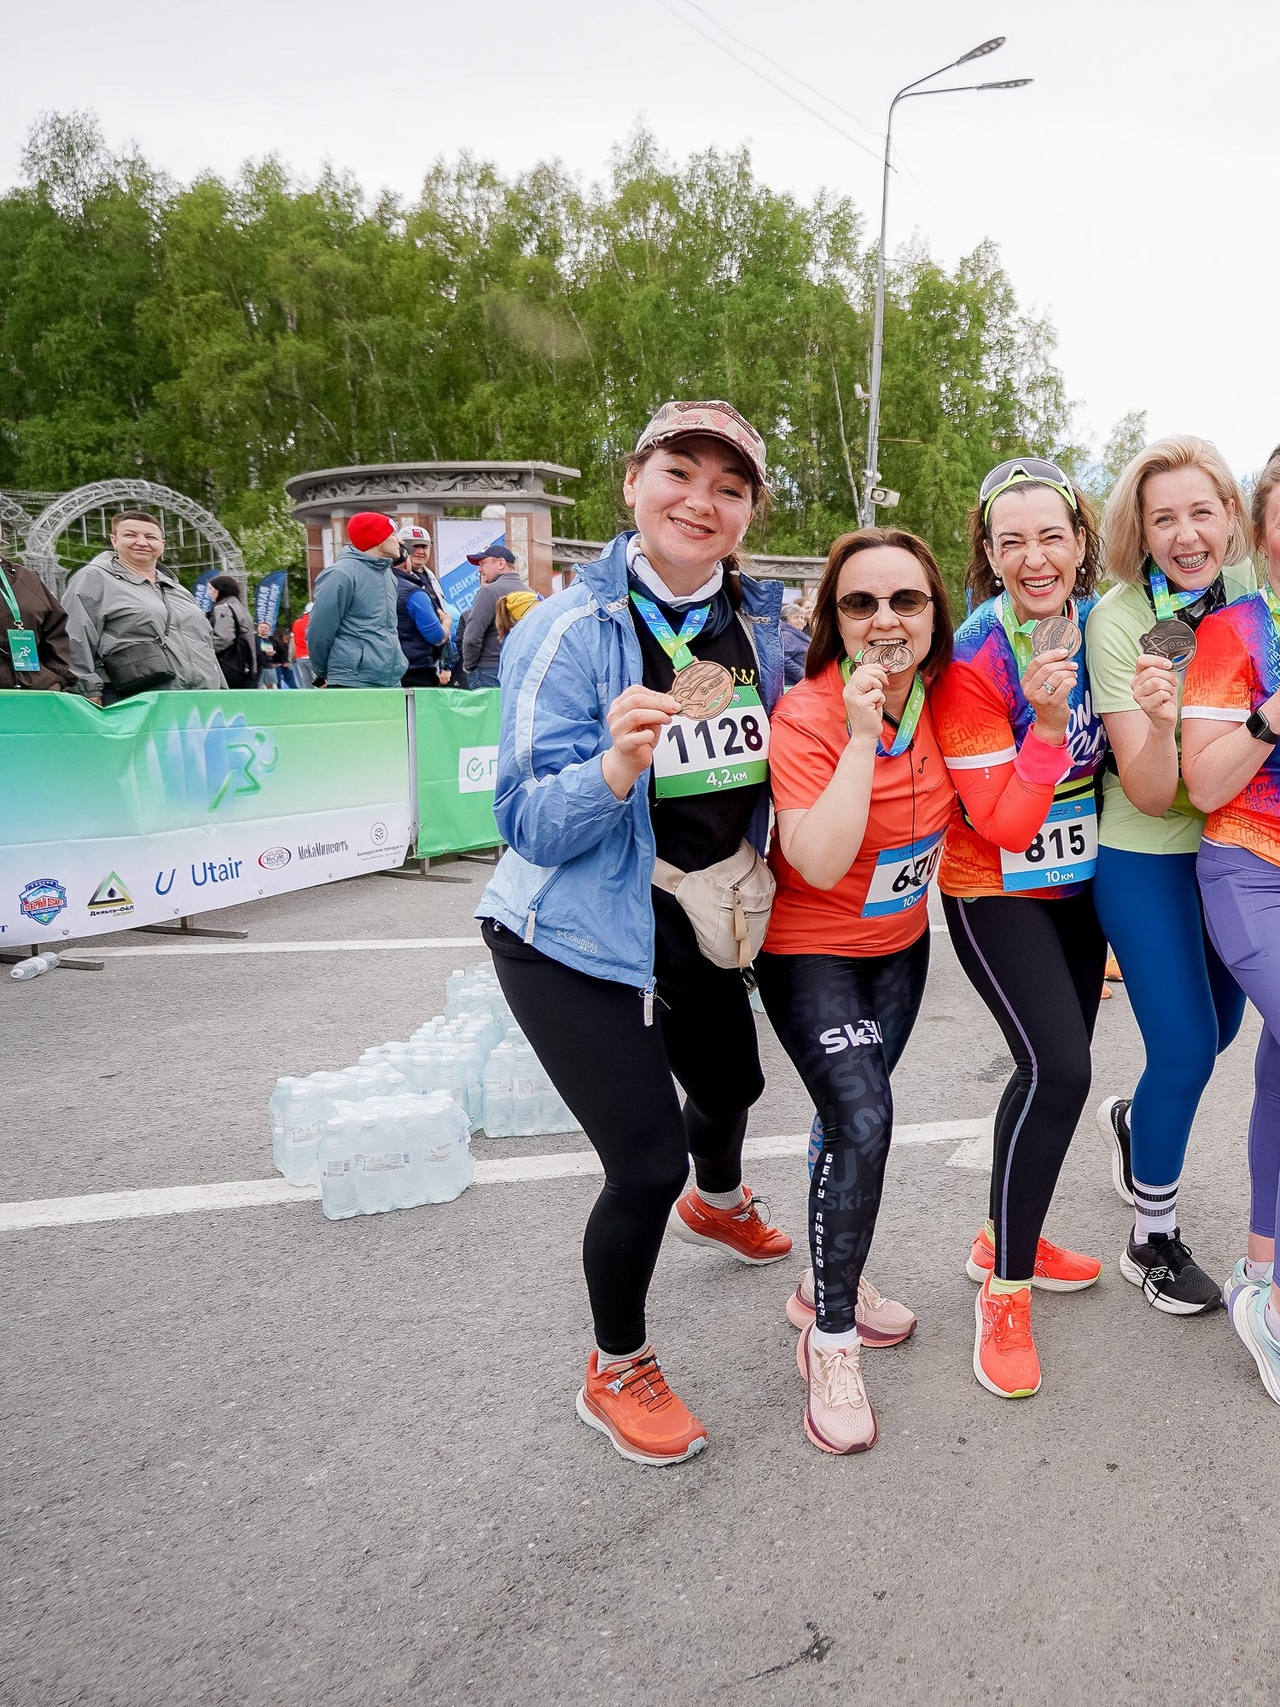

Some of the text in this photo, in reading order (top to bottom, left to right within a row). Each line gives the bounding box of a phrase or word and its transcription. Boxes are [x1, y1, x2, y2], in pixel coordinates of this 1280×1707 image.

[443, 531, 493, 566] ФЕСТИВАЛЬ
[449, 571, 480, 599] ДВИЖ
[667, 715, 763, 764] 1128
[1025, 824, 1085, 863] 815
[192, 857, 243, 887] Utair
[563, 931, 599, 951] Columbia
[817, 1153, 834, 1199] БЕГУ
[814, 1212, 825, 1268] ЛЮБЛЮ
